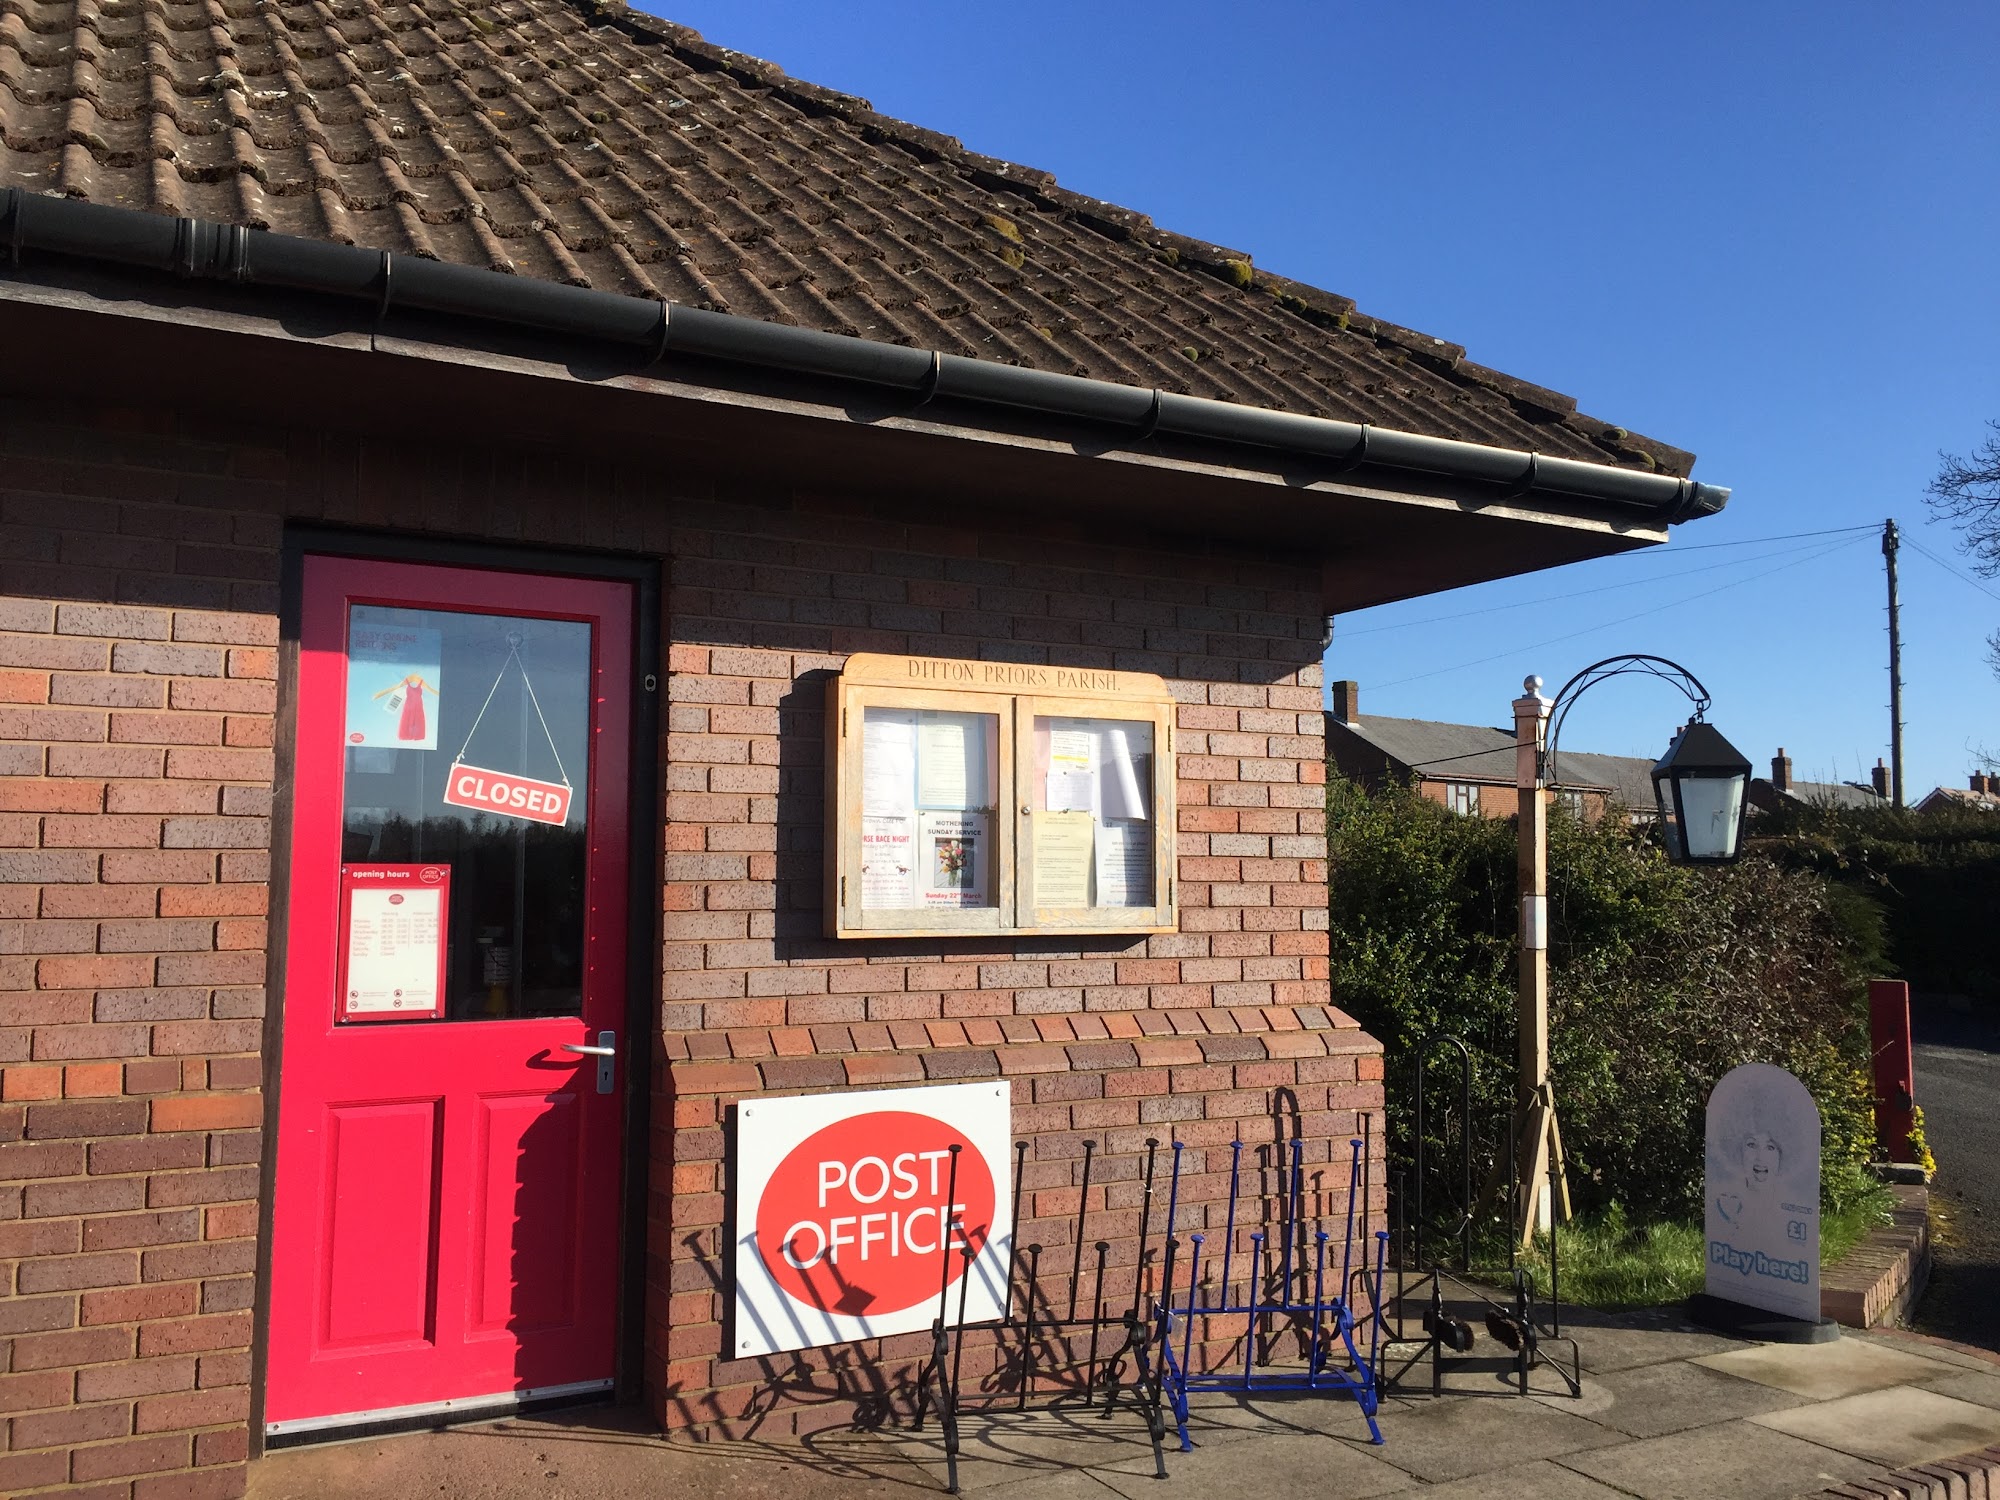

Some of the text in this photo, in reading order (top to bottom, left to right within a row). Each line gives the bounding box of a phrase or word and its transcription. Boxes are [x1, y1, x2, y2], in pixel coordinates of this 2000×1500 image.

[355, 639, 397, 650] RETNS
[908, 659, 1121, 691] DITTON PRIORS PARISH.
[457, 775, 562, 815] CLOSED
[875, 835, 890, 843] RACE
[892, 835, 910, 843] NIGHT
[352, 869, 410, 879] opening hours
[818, 1149, 950, 1208] POST
[782, 1203, 967, 1270] OFFICE
[1787, 1220, 1807, 1241] £1
[1710, 1241, 1809, 1285] Play here!
